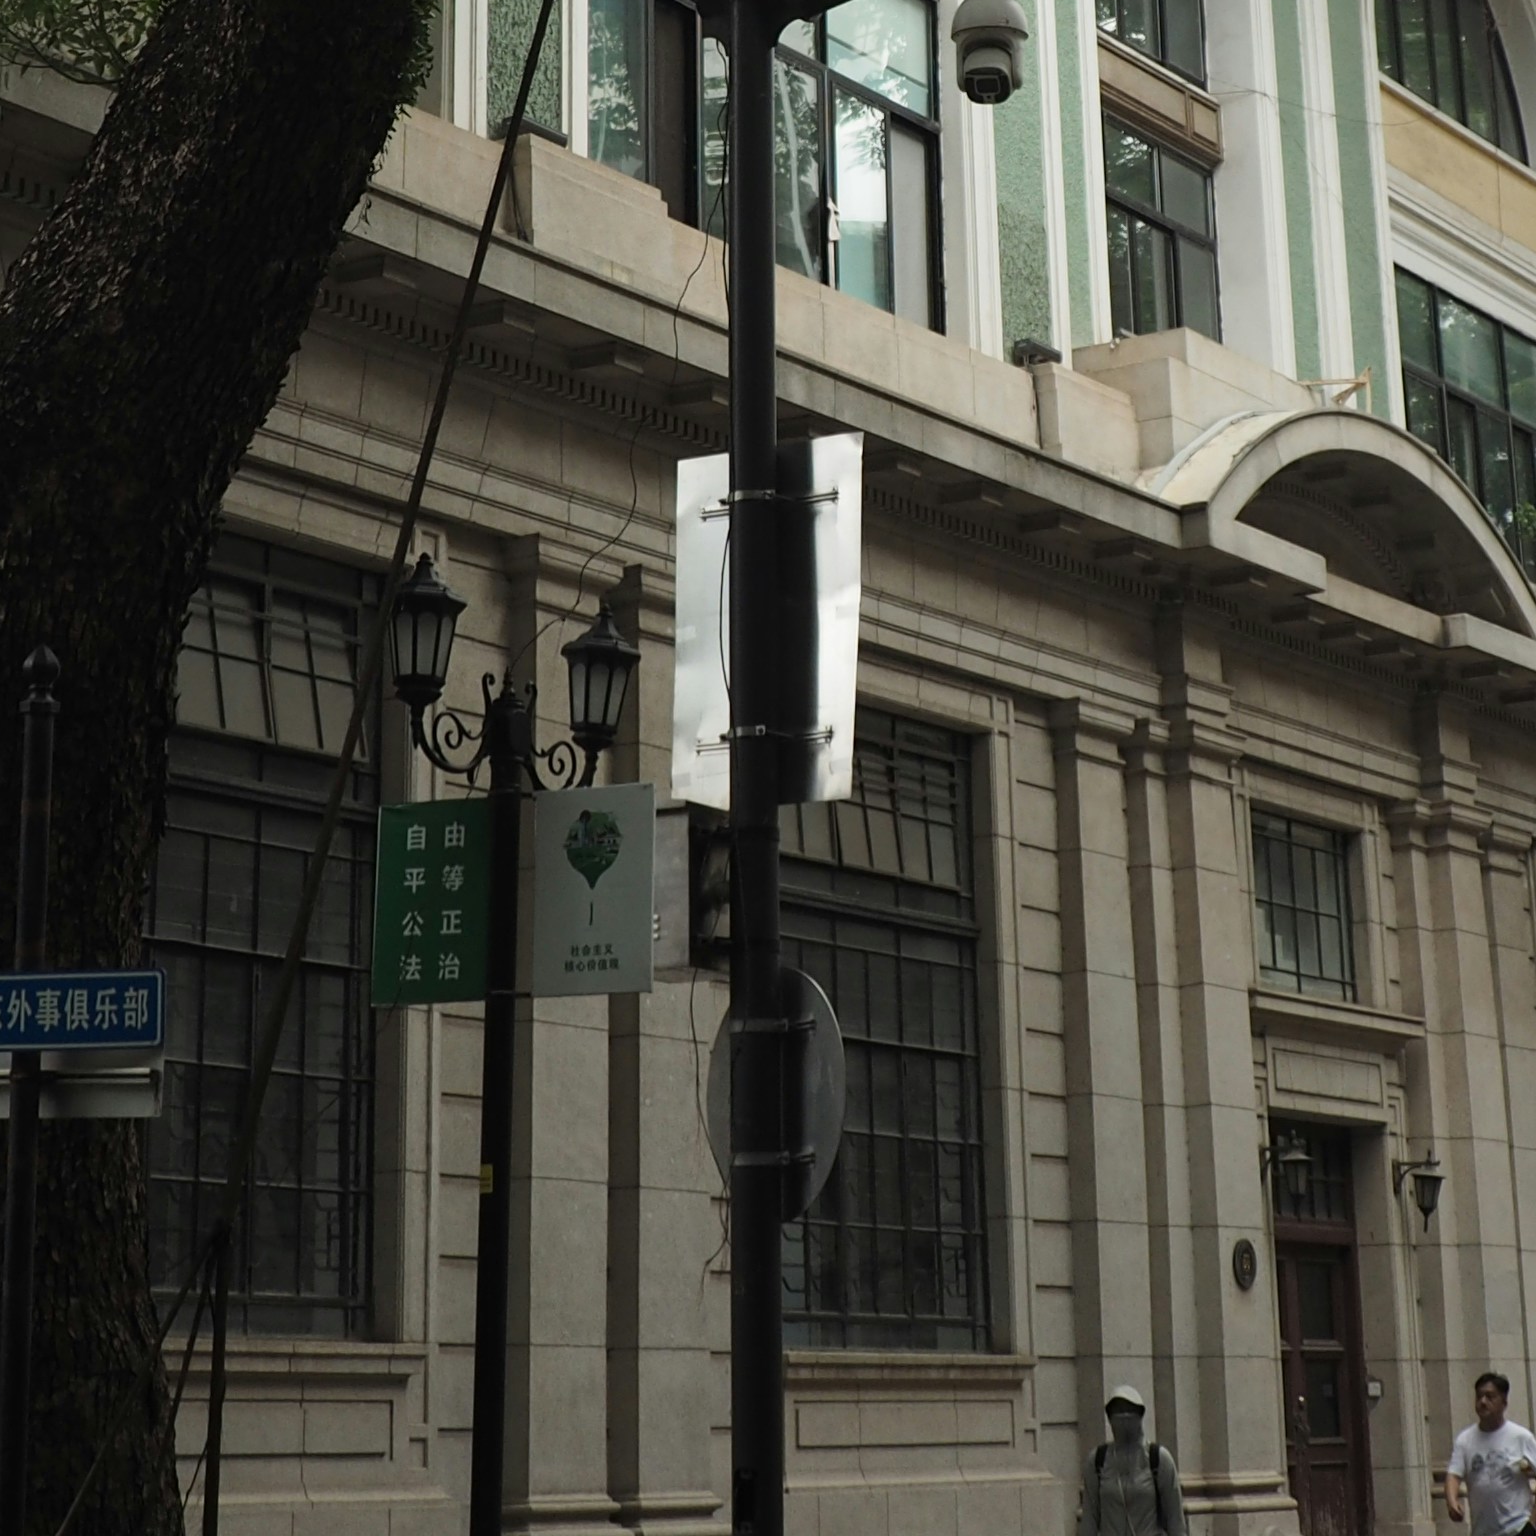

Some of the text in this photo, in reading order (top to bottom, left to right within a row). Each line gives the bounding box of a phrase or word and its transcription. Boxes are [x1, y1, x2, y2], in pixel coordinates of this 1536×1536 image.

[406, 820, 466, 851] 自由
[403, 864, 464, 895] 平等
[401, 909, 463, 938] 公正
[570, 943, 614, 957] 社会主义
[399, 952, 461, 982] 法治
